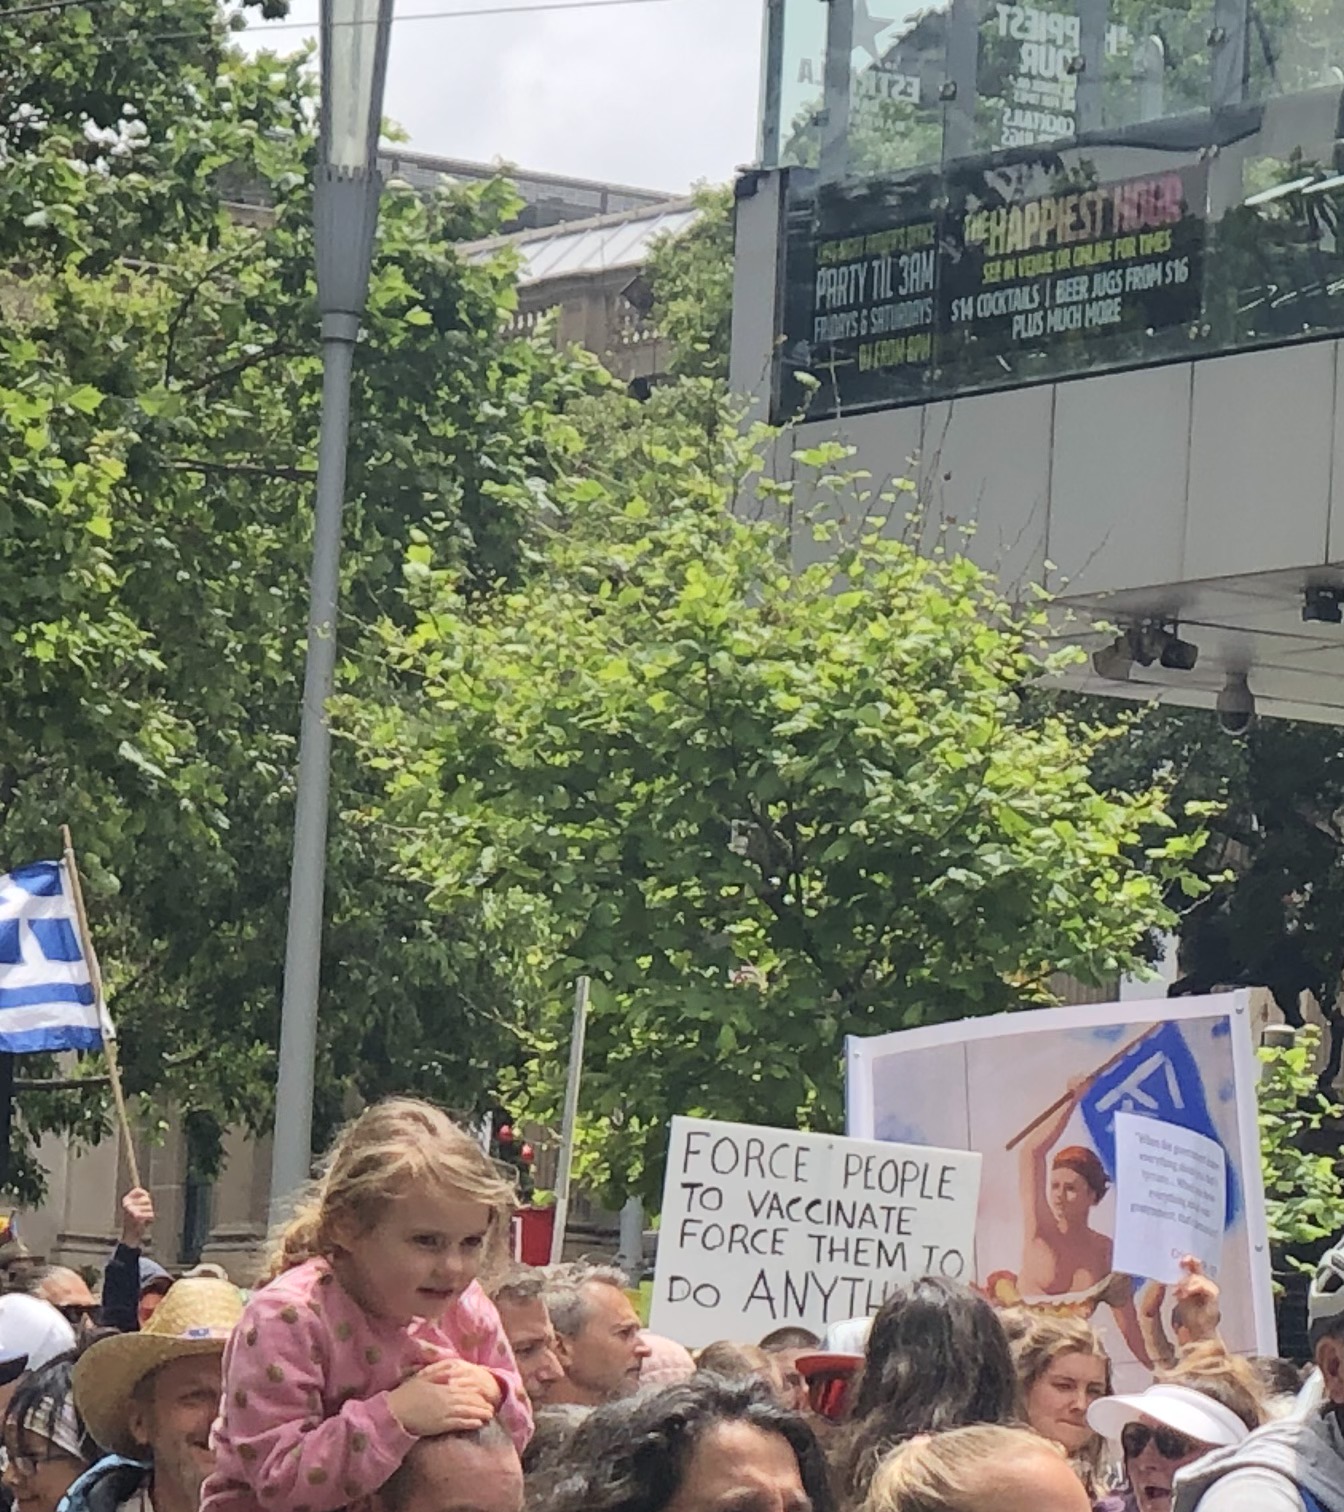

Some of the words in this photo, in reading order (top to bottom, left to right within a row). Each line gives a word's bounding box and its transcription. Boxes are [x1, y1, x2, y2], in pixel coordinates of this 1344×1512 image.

[985, 188, 1109, 256] HAPPIEST
[815, 261, 868, 310] PARTY
[872, 256, 894, 300] TIL
[898, 250, 935, 296] 3AM
[977, 284, 1041, 319] COCKTAILS
[1055, 274, 1089, 304] BEER
[1091, 267, 1123, 299] JUGS
[1125, 261, 1162, 292] FROM
[1012, 311, 1044, 340] PLUS
[1047, 303, 1082, 333] MUCH
[1085, 297, 1122, 328] MORE
[682, 1131, 810, 1182] FORCE
[843, 1153, 956, 1200] PEOPLE
[681, 1182, 723, 1213] TO
[748, 1190, 917, 1236] VACCINATE
[679, 1218, 789, 1256] FORCE
[808, 1233, 907, 1272] THEM
[922, 1244, 964, 1279] TO
[668, 1275, 721, 1308] DO
[743, 1269, 896, 1323] ANYTH
